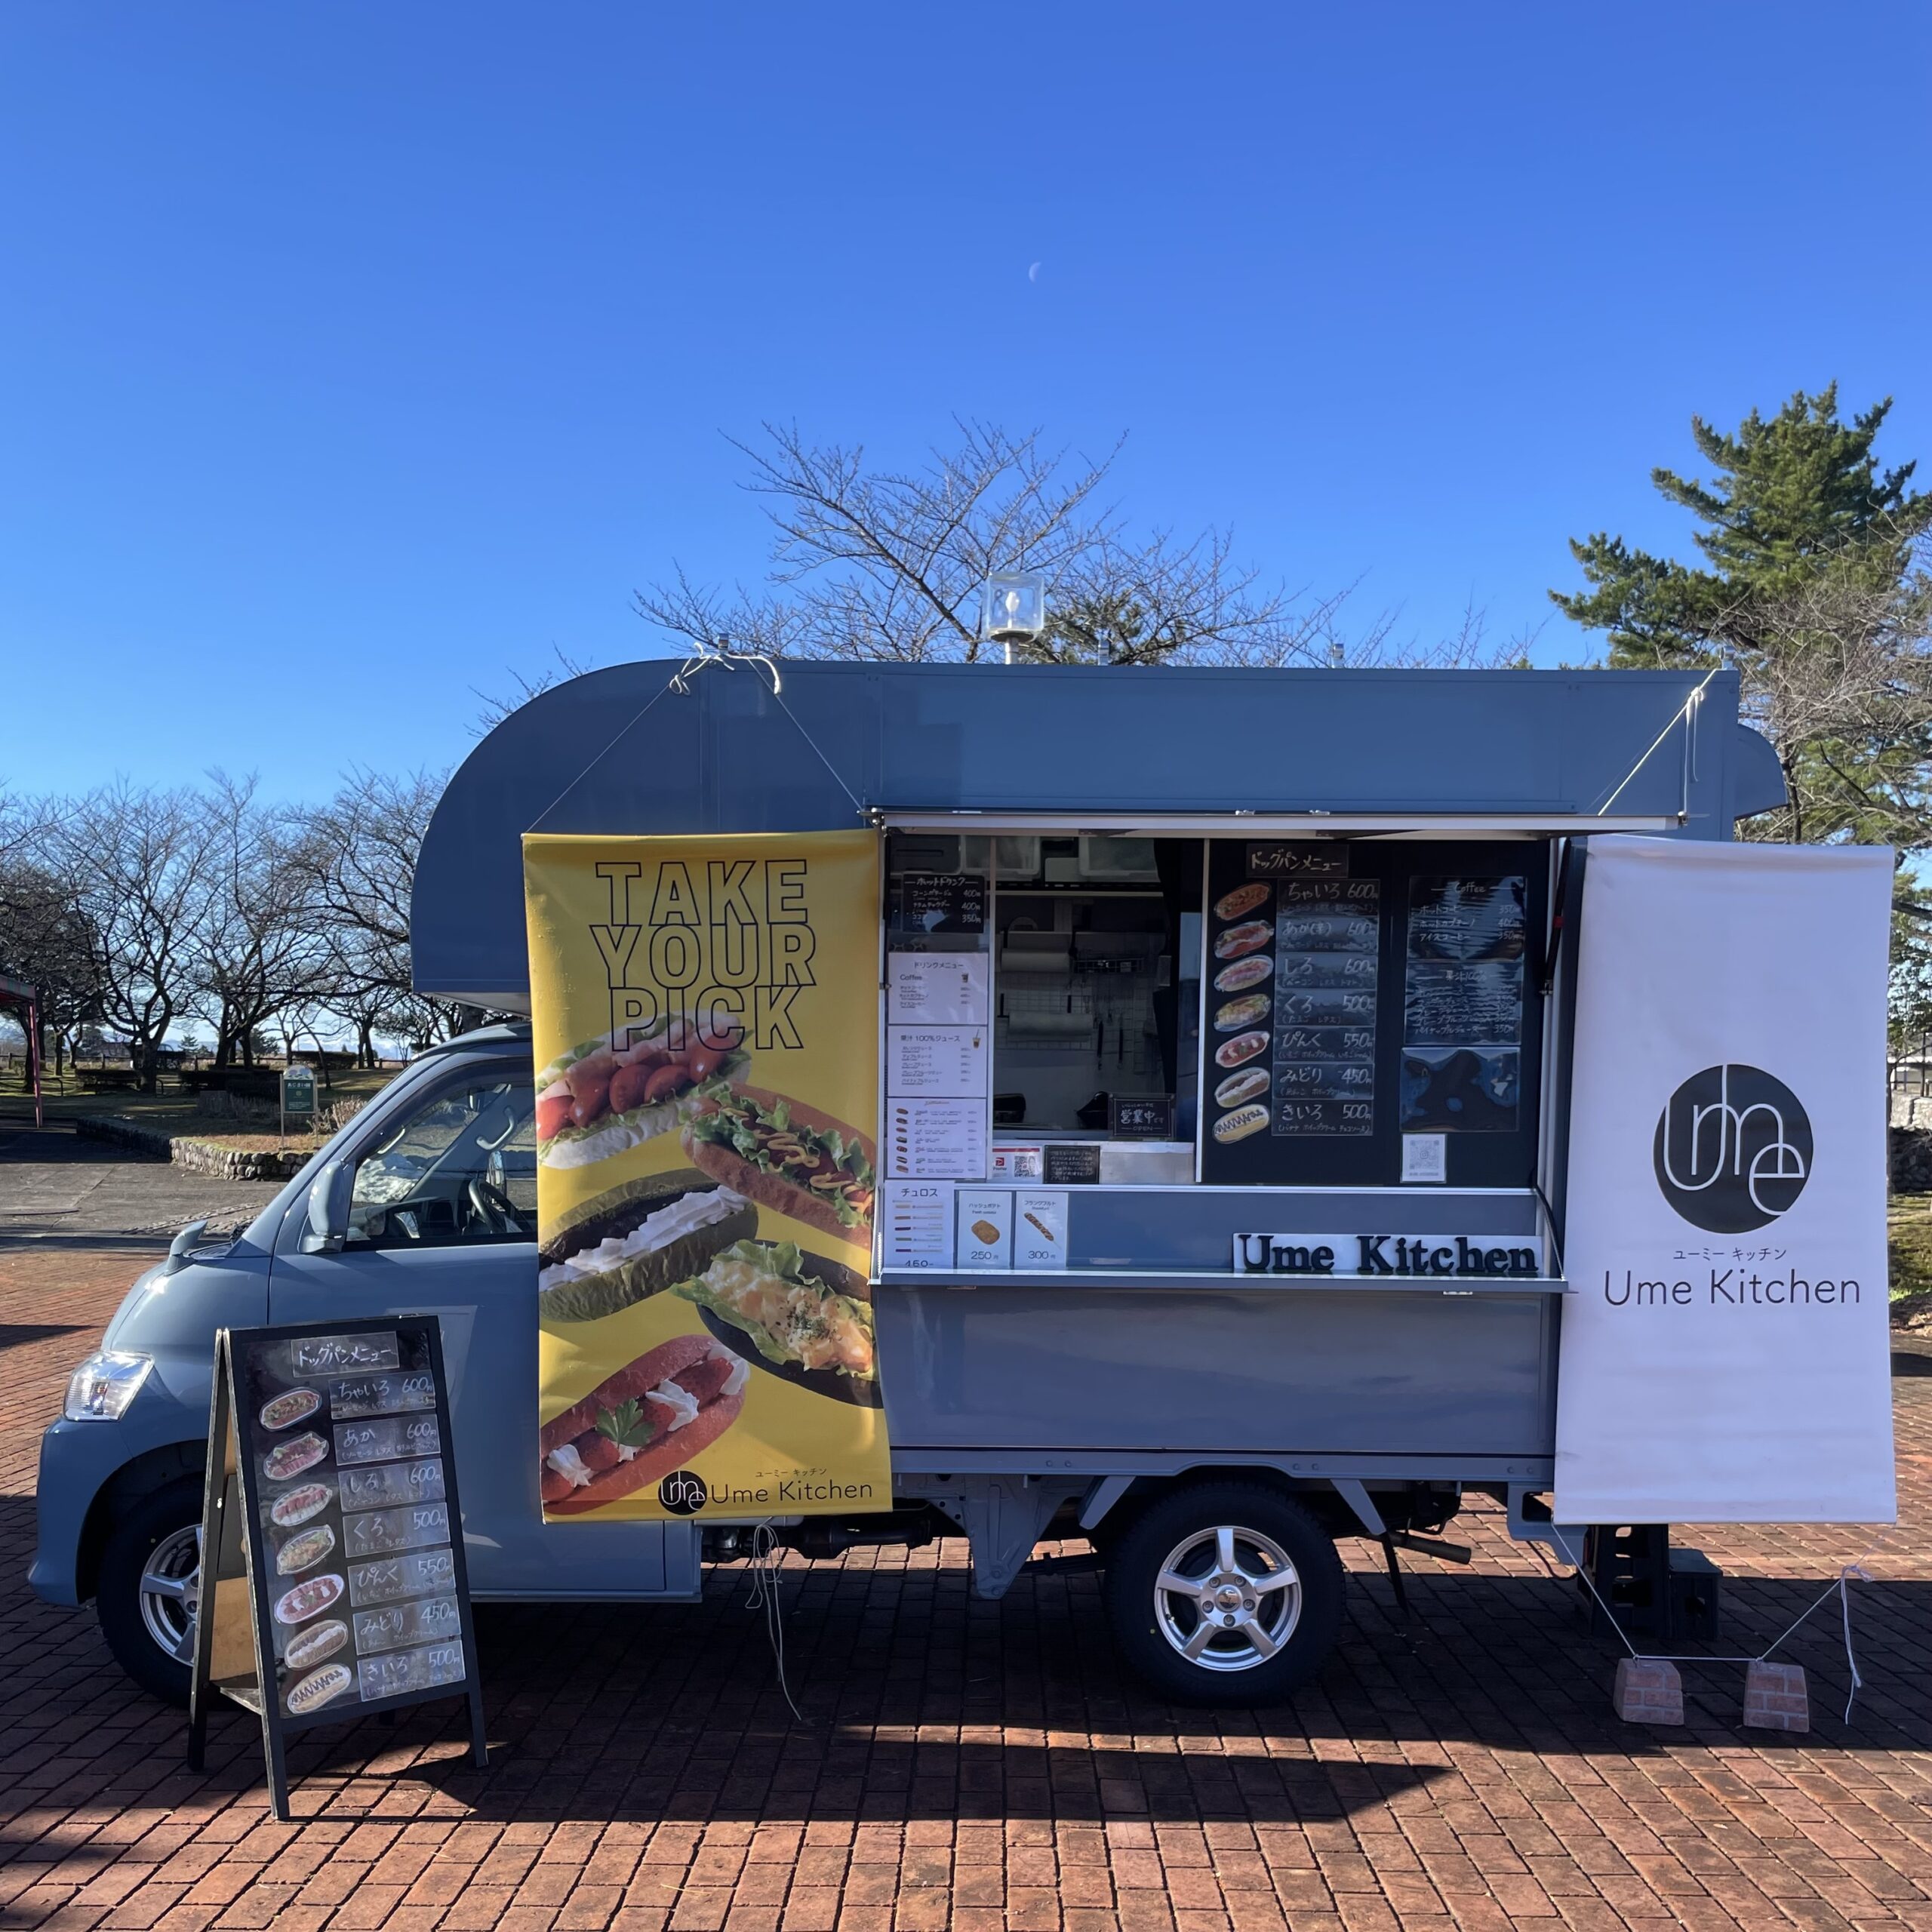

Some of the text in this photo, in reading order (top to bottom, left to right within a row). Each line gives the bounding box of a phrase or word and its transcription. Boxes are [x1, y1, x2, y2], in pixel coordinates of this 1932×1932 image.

[1251, 848, 1343, 871] ドッグパンメニュー
[595, 859, 808, 926] TAKE
[1288, 882, 1340, 900] ちゃいろ
[589, 922, 817, 989] YOUR
[1284, 957, 1313, 975] しろ
[1284, 995, 1314, 1014] くろ
[610, 984, 804, 1052] PICK
[1281, 1031, 1321, 1048] ぴんく
[1280, 1066, 1322, 1084] みどり
[1281, 1103, 1322, 1121] きいろ
[901, 1188, 938, 1197] チュロス
[1238, 1234, 1540, 1273] Ume Kitchen
[1673, 1247, 1787, 1262] ユーミー キッチン
[1604, 1268, 1860, 1306] Ume Kitchen
[299, 1343, 392, 1367] ドッグパンメニュー
[338, 1380, 389, 1401] ちゃいろ
[343, 1428, 377, 1447] あか
[350, 1473, 379, 1494] しろ
[755, 1467, 828, 1478] ユーミー キッチン
[711, 1478, 872, 1504] Ume Kitchen
[353, 1517, 384, 1540] くろ
[357, 1564, 398, 1588] ぴんく
[360, 1611, 404, 1635] みどり
[367, 1656, 408, 1681] きいろ
